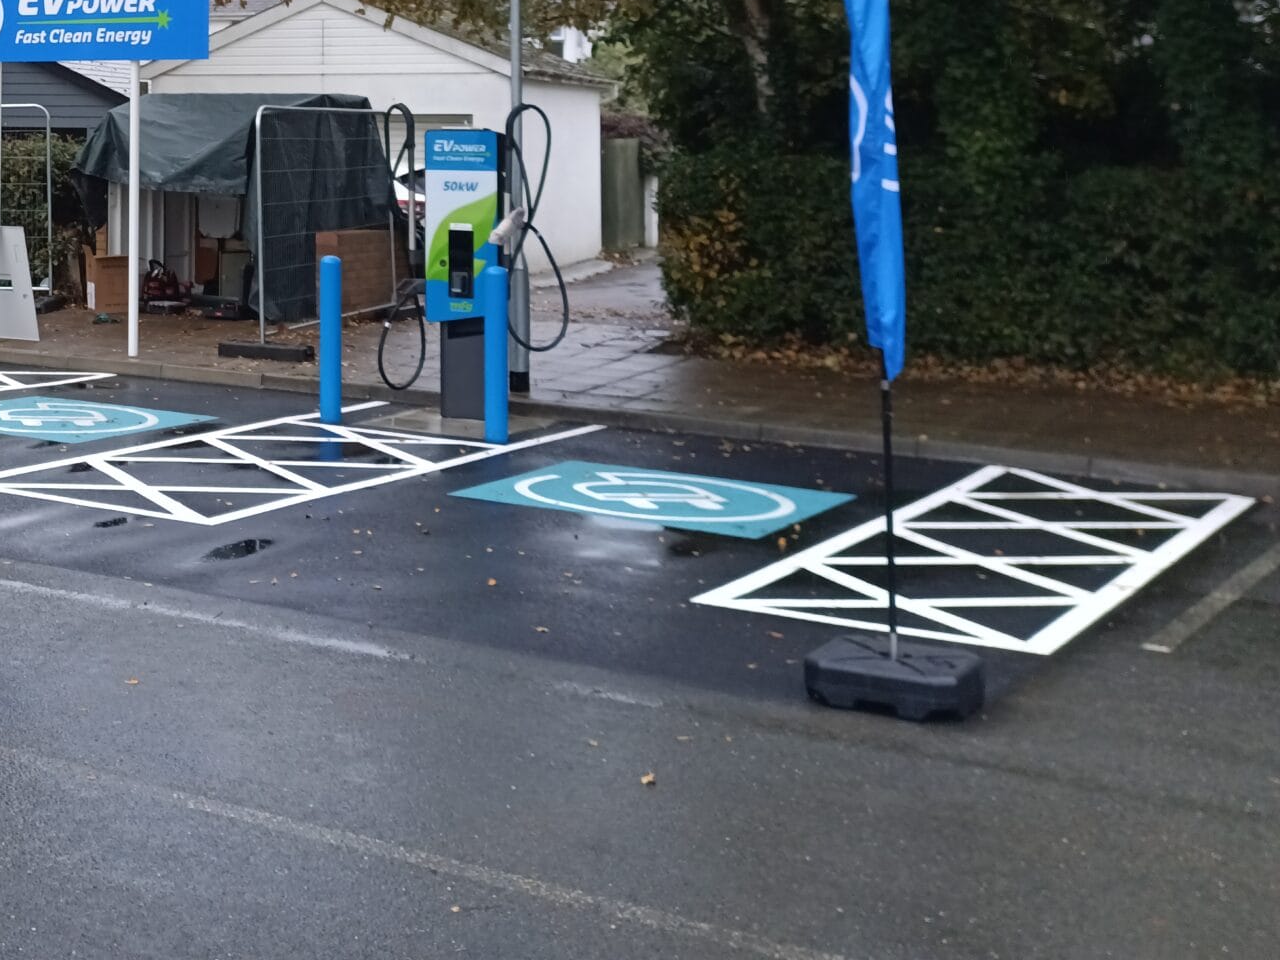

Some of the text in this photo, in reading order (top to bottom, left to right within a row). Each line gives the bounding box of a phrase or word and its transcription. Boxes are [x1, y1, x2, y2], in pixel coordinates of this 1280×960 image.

[15, 27, 152, 45] Fast Clean Energy
[443, 180, 479, 192] 50kW
